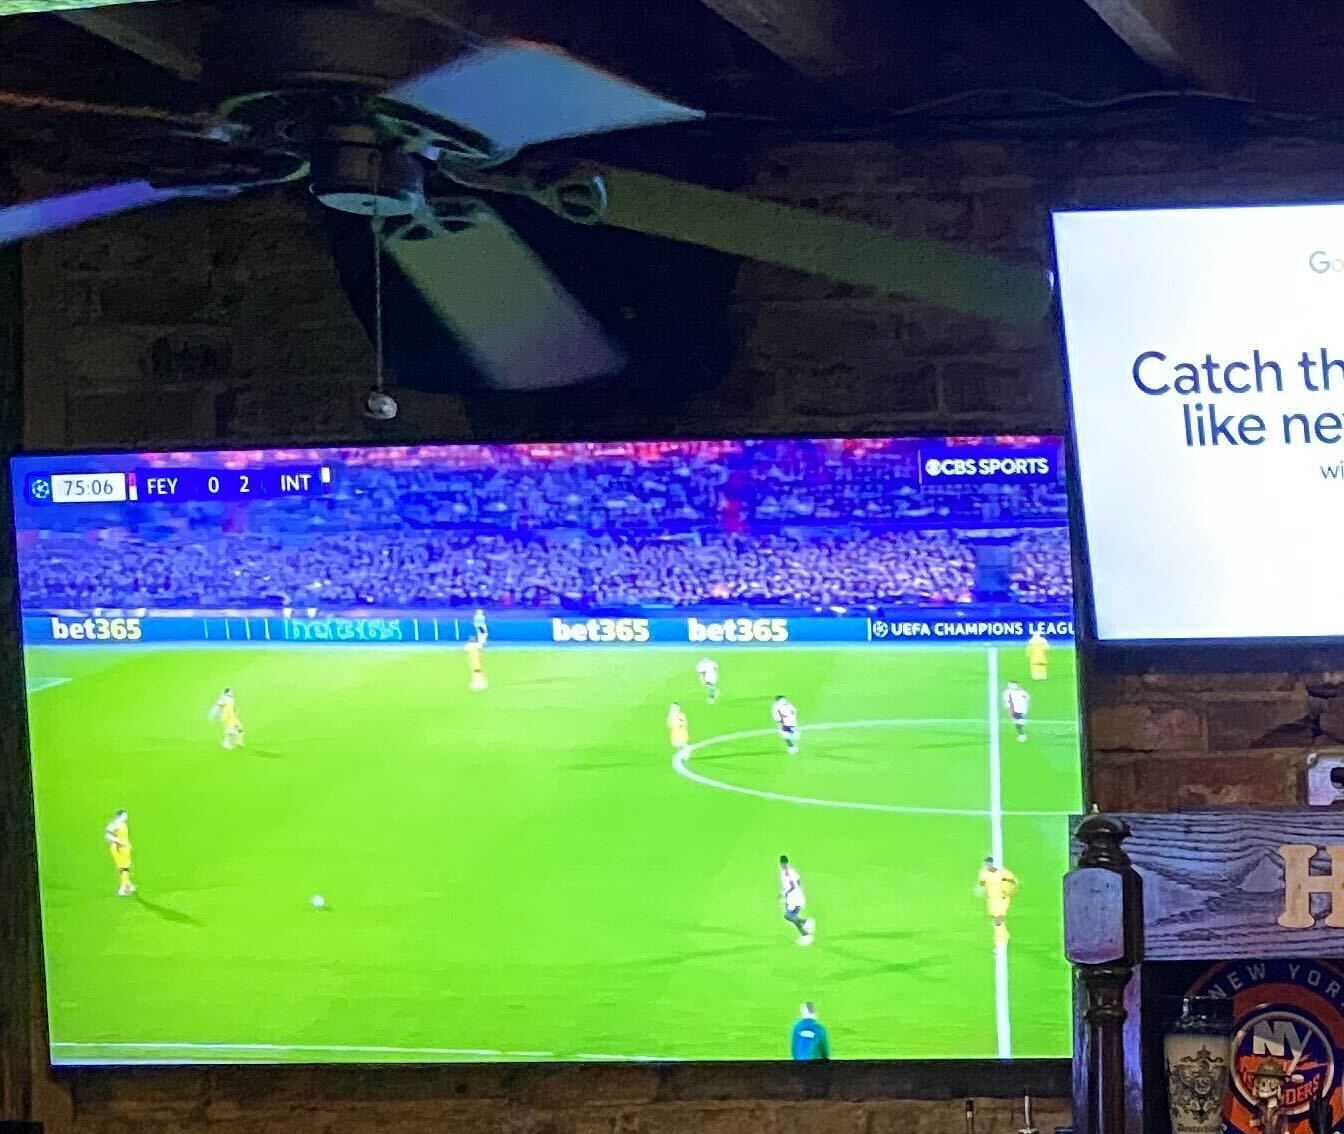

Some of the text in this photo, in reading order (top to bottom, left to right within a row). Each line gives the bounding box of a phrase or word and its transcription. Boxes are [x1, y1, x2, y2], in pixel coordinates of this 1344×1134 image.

[1132, 349, 1283, 396] Catch
[1182, 402, 1267, 447] like
[942, 458, 1049, 475] CBS SPORTS
[64, 479, 113, 496] 75:06
[146, 474, 312, 495] FEY 0 2 INT
[51, 618, 142, 640] bet365
[552, 619, 649, 641] bet365
[688, 619, 788, 641] bet365
[891, 622, 930, 637] UEFA
[934, 621, 1023, 637] CHAMPIONS
[1207, 963, 1266, 999] NEW
